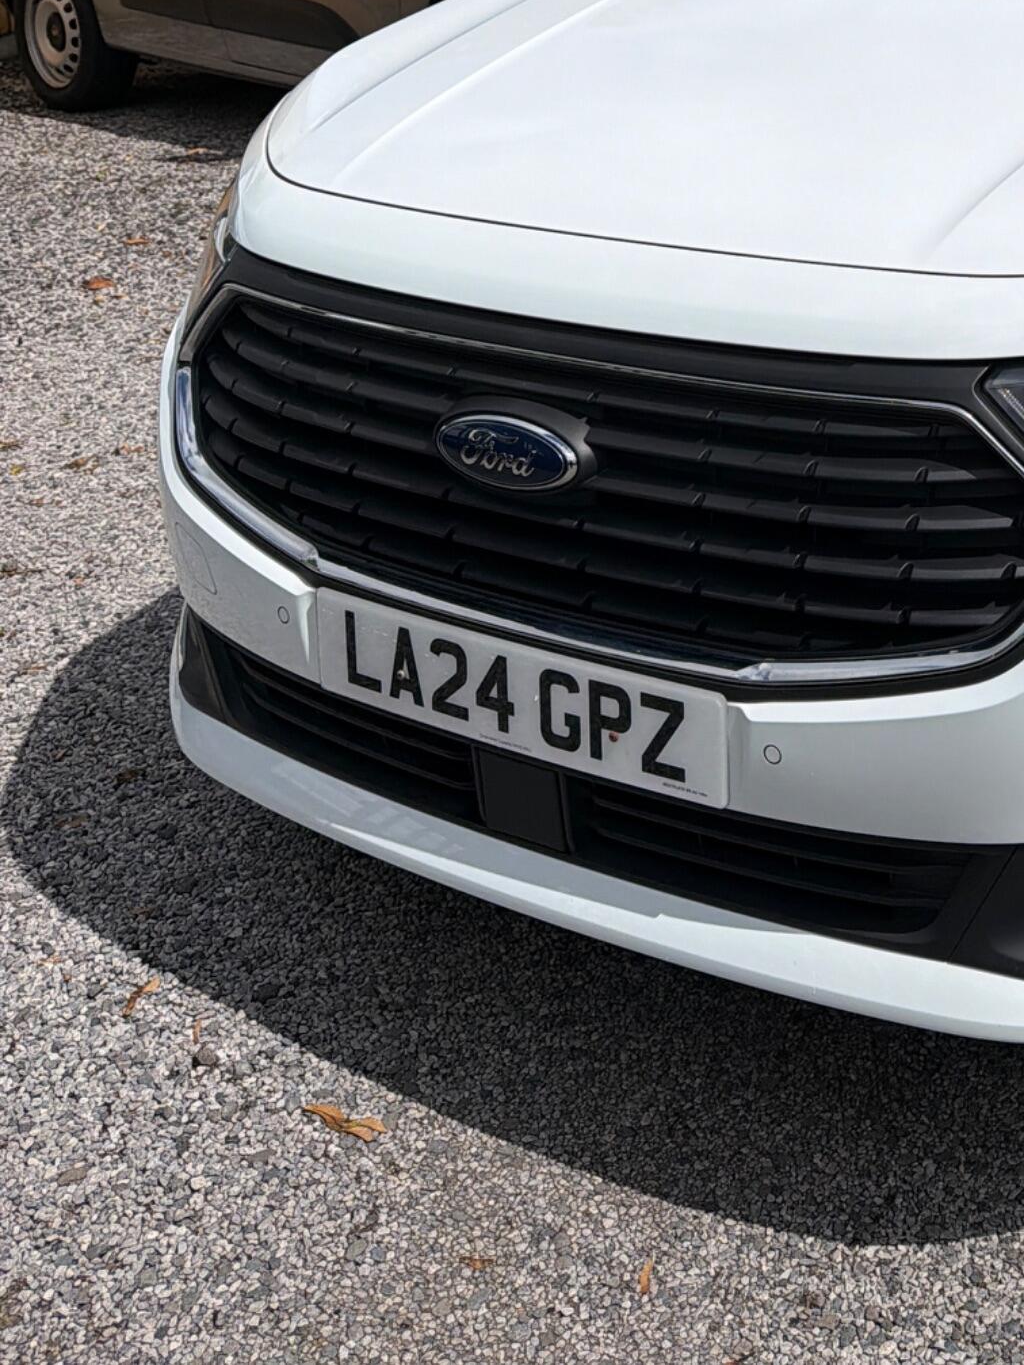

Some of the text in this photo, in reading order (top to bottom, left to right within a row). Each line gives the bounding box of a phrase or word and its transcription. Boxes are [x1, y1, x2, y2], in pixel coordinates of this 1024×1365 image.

[460, 428, 537, 478] Ford
[344, 609, 687, 784] LA24 GPZ
